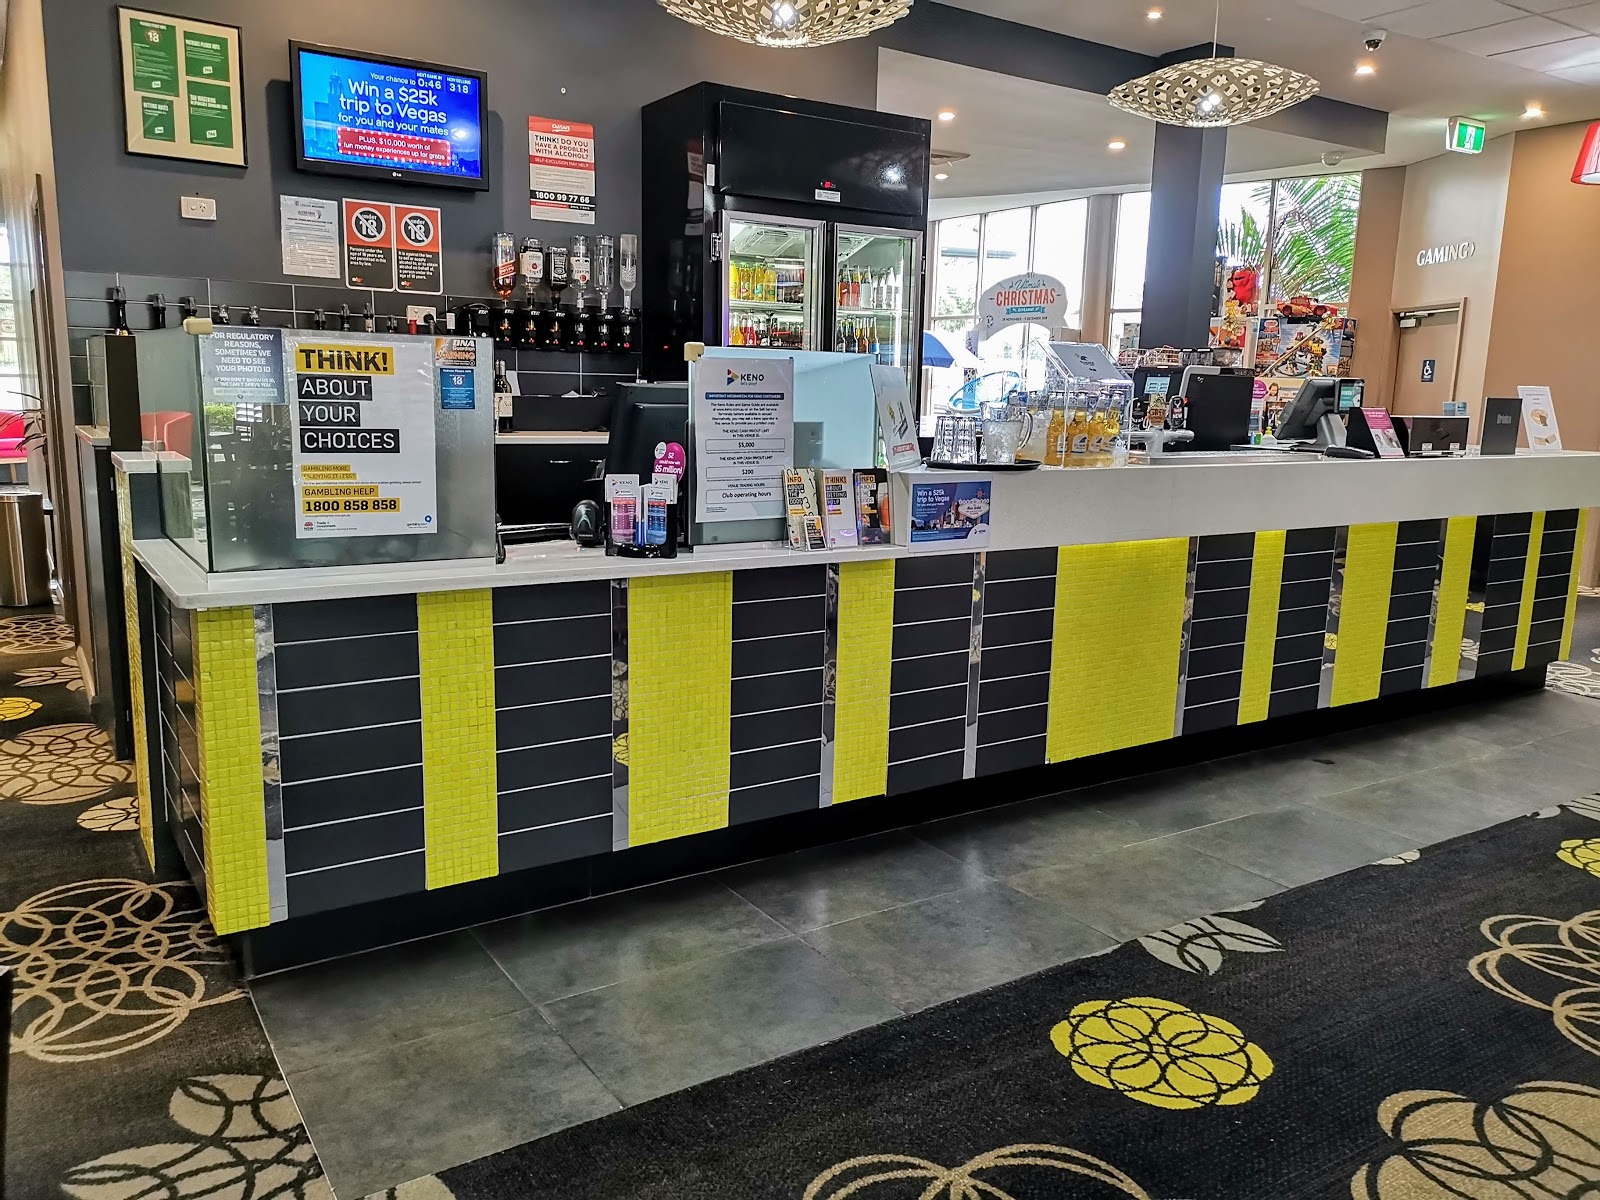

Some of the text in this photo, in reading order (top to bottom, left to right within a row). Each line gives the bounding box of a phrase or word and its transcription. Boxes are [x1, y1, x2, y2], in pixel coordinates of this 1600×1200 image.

[370, 72, 384, 80] Your
[386, 75, 408, 84] chance
[418, 78, 441, 89] 0:46
[348, 78, 438, 106] Win a $25k
[450, 83, 468, 94] 318
[340, 94, 446, 124] trip to Vegas
[338, 113, 449, 136] for you and your mates
[379, 137, 406, 148] $10,000
[535, 134, 559, 143] THINK!
[376, 146, 410, 156] experiences
[420, 149, 428, 158] for
[555, 150, 588, 159] ALCOHOL?
[560, 145, 588, 153] PROBLEM
[534, 157, 568, 165] SELF-EXCLUSION
[536, 192, 555, 200] 1800
[360, 219, 377, 236] 18
[408, 224, 425, 240] 18
[1416, 242, 1470, 266] GAMING
[996, 288, 1056, 306] CHRISTMAS
[226, 332, 274, 341] REGULATORY
[224, 340, 261, 349] REASONS,
[299, 349, 388, 371] THINK!
[453, 376, 463, 385] 18
[302, 378, 368, 396] ABOUT
[302, 405, 356, 422] YOUR
[304, 432, 395, 448] CHOICES
[663, 465, 682, 474] million!
[306, 500, 396, 512] 1800 858 858
